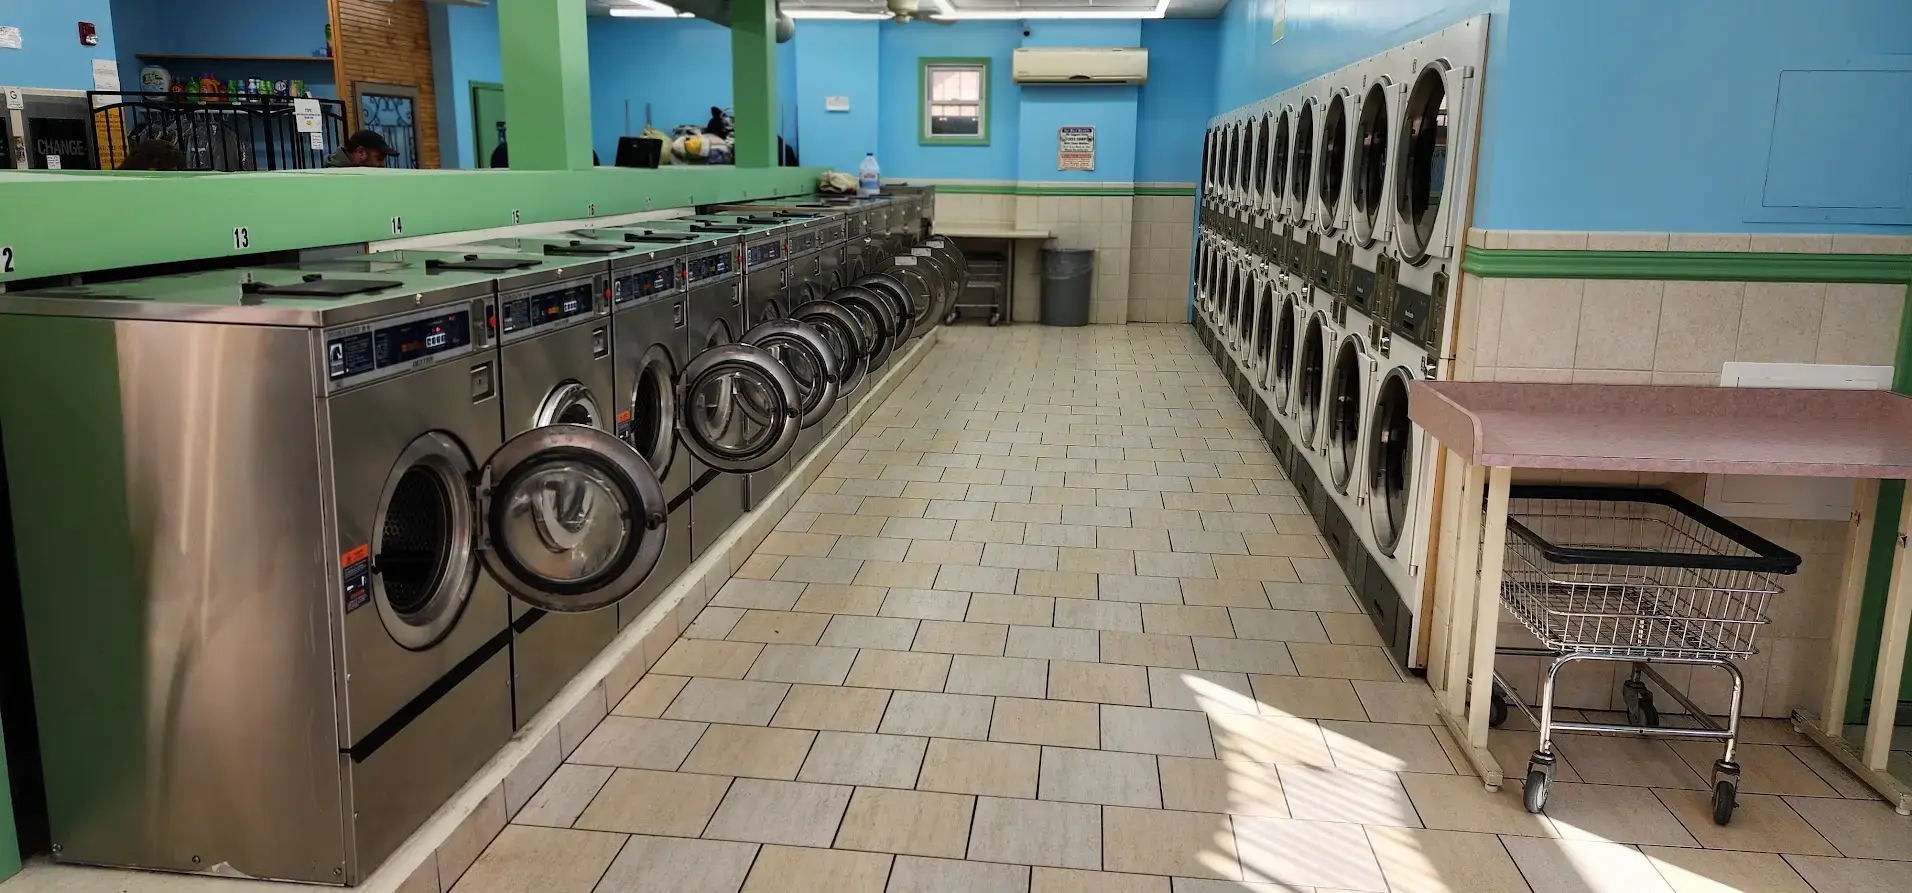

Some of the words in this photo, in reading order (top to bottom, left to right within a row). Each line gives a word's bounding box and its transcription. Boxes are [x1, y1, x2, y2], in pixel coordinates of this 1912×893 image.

[37, 139, 86, 155] CHANGE
[392, 216, 402, 234] 14
[512, 210, 520, 224] 15
[234, 227, 249, 249] 13
